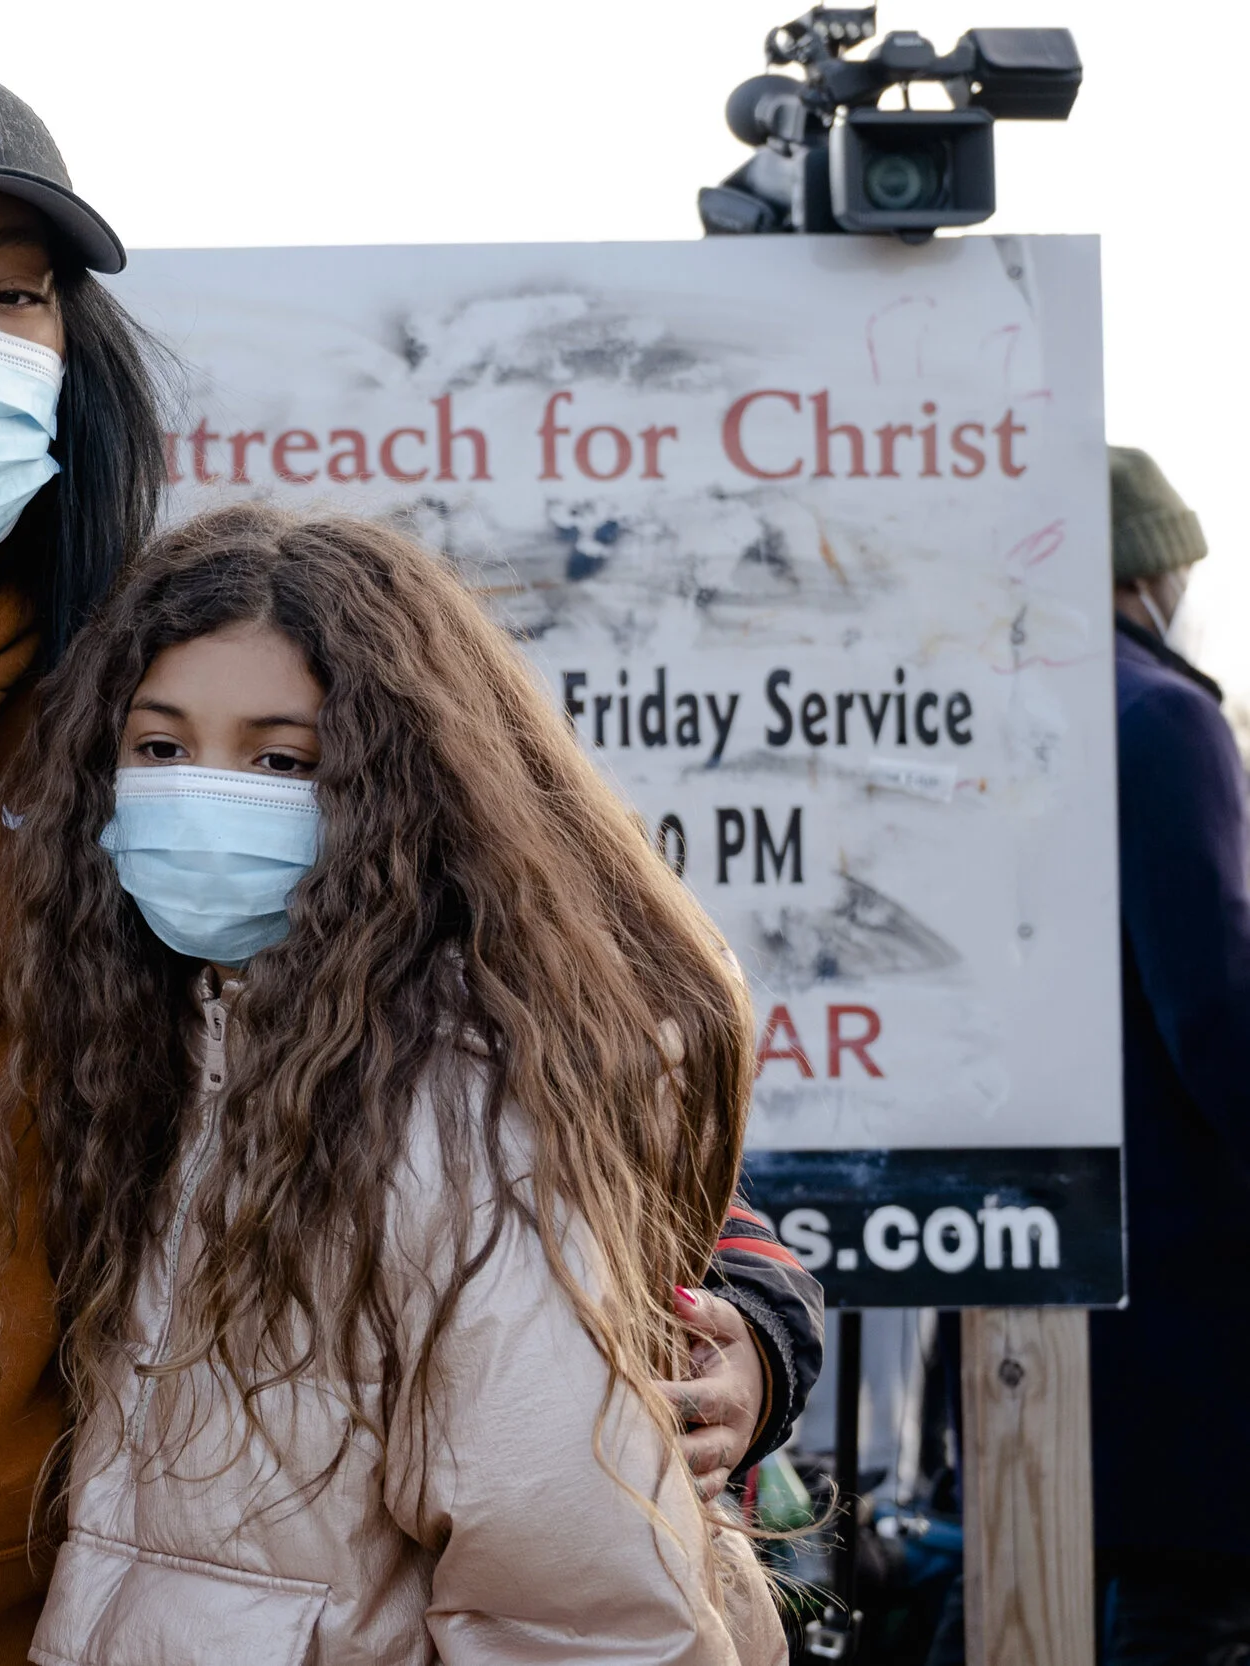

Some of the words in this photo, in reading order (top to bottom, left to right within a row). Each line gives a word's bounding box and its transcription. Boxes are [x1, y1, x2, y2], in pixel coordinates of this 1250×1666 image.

[535, 391, 678, 482] for
[720, 387, 1028, 480] Christ
[562, 666, 740, 769] Friday
[764, 666, 974, 747] Service
[715, 806, 804, 885] PM
[753, 1003, 886, 1079] AR
[756, 1200, 1061, 1273] s.com
